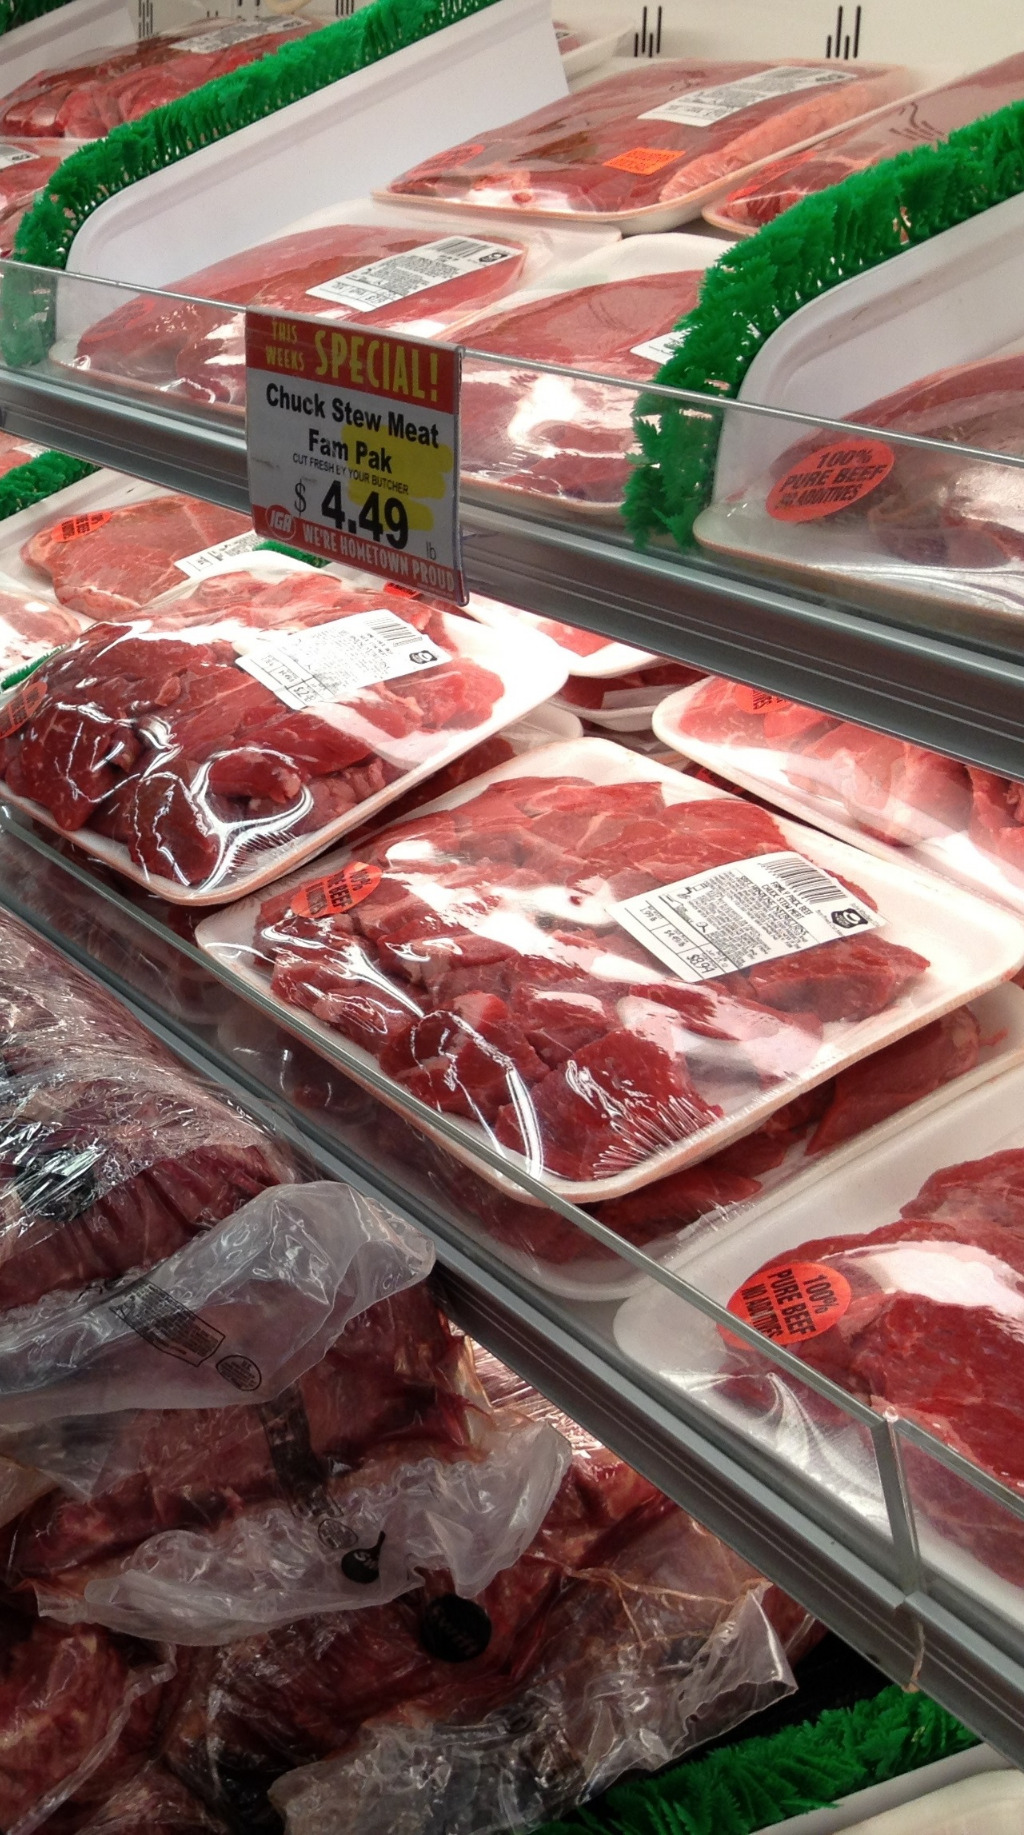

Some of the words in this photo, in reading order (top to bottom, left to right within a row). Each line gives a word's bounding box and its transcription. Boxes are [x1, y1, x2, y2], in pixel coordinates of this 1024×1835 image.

[271, 318, 298, 344] THIS
[266, 346, 305, 372] WEEKS
[315, 330, 439, 402] SPECIAL!
[266, 383, 326, 419] Chuck
[332, 398, 382, 432] Stew
[388, 411, 439, 448] Meat
[308, 428, 349, 462] Fam
[356, 441, 392, 474] Pak
[817, 449, 873, 468] 100%
[293, 453, 308, 466] CUT
[309, 458, 335, 474] FRESH
[348, 467, 370, 486] YOUR
[372, 476, 409, 495] BUTCHER
[269, 510, 293, 533] IGA
[294, 479, 307, 515] $
[321, 480, 408, 549] 4.49
[303, 524, 337, 551] WE'RE
[340, 536, 409, 577] HOMETOWN
[413, 561, 455, 592] PROUD
[426, 542, 437, 561] lb
[768, 1268, 803, 1305] PURE
[803, 1274, 839, 1315] 100%
[781, 1302, 816, 1335] BEEF
